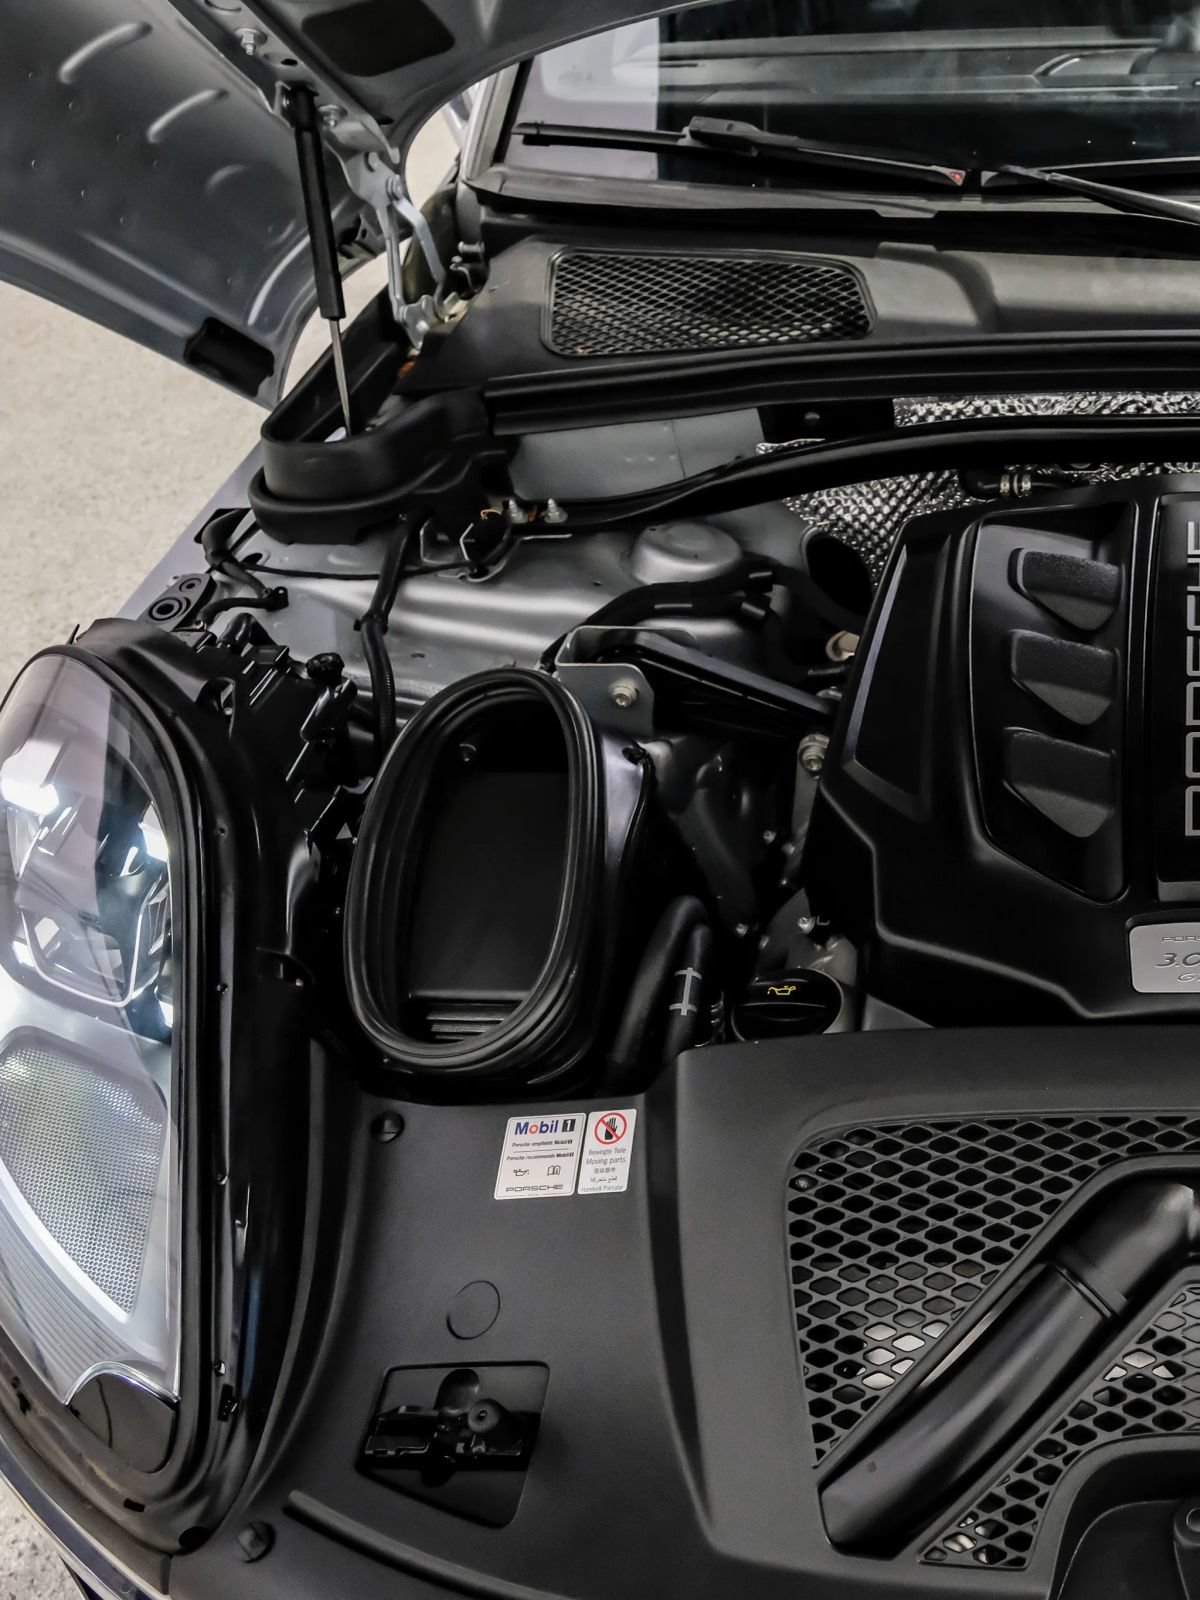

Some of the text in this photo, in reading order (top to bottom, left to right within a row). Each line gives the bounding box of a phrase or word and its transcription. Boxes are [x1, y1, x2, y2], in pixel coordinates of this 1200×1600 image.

[514, 1118, 577, 1136] Mobil 1
[585, 1157, 627, 1166] Moving parts
[505, 1183, 564, 1193] PORSCHE
